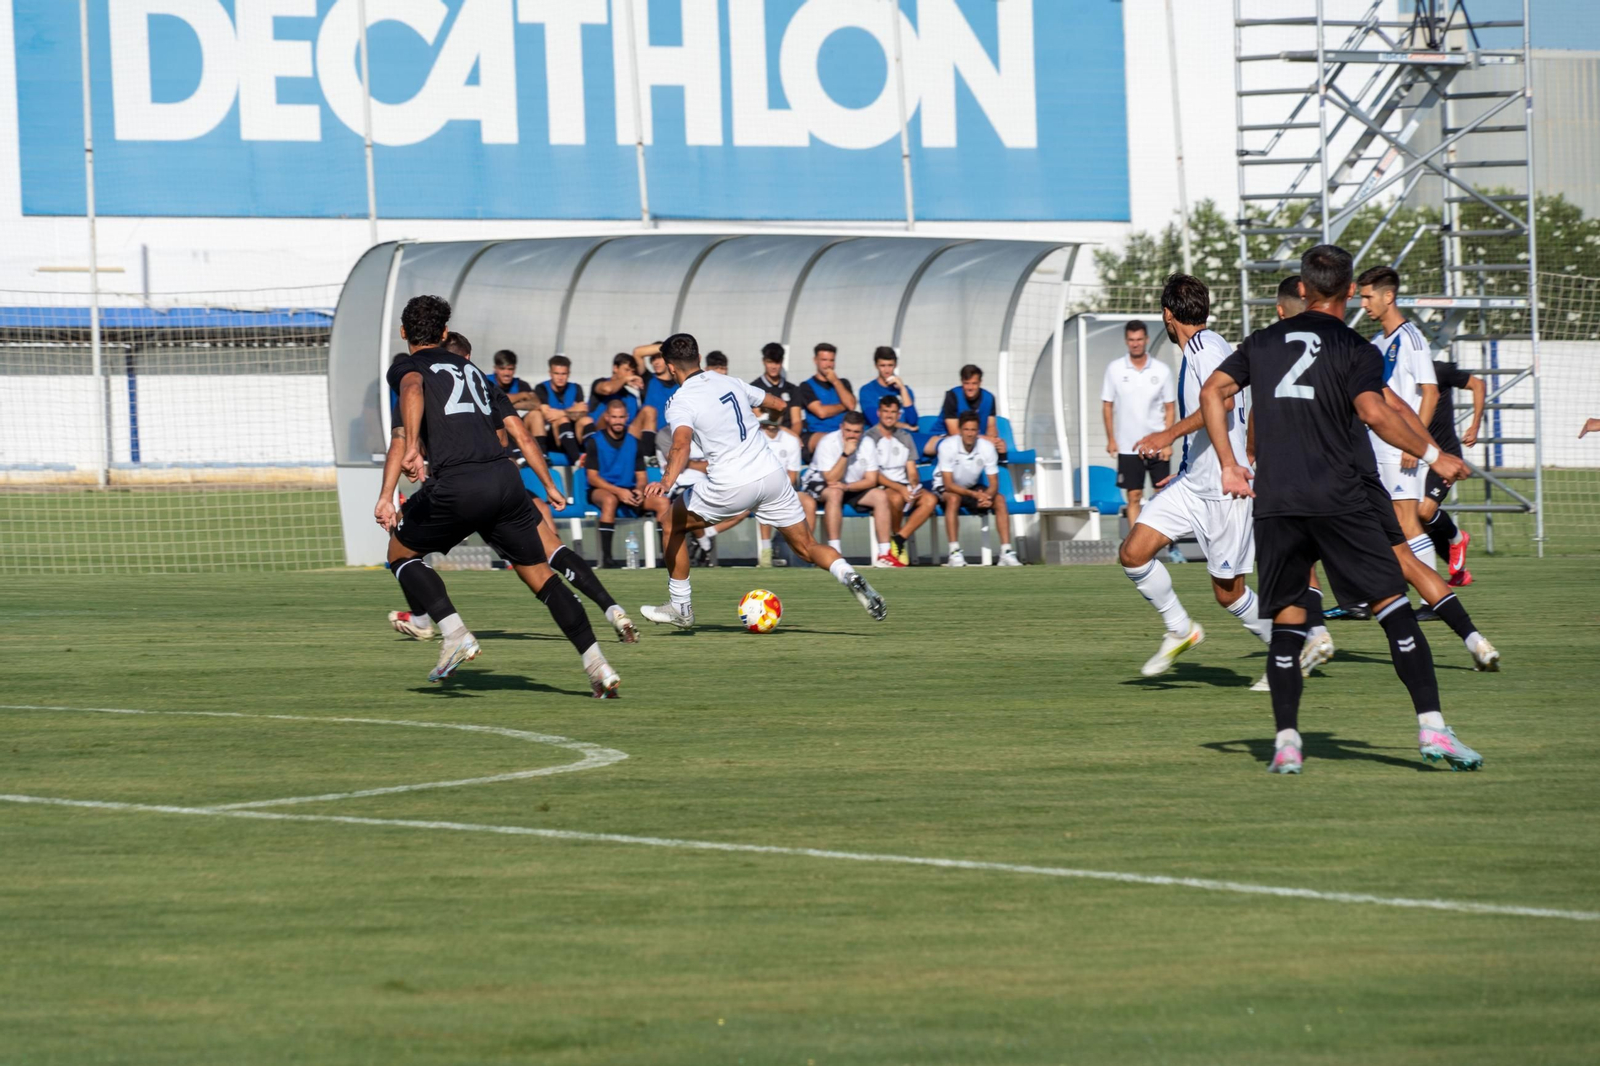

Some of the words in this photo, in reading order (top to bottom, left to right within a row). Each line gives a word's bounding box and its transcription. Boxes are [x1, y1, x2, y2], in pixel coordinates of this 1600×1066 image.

[108, 0, 1038, 149] DECATHLON
[429, 363, 492, 415] 20
[1274, 331, 1322, 400] 2
[719, 391, 747, 442] 7
